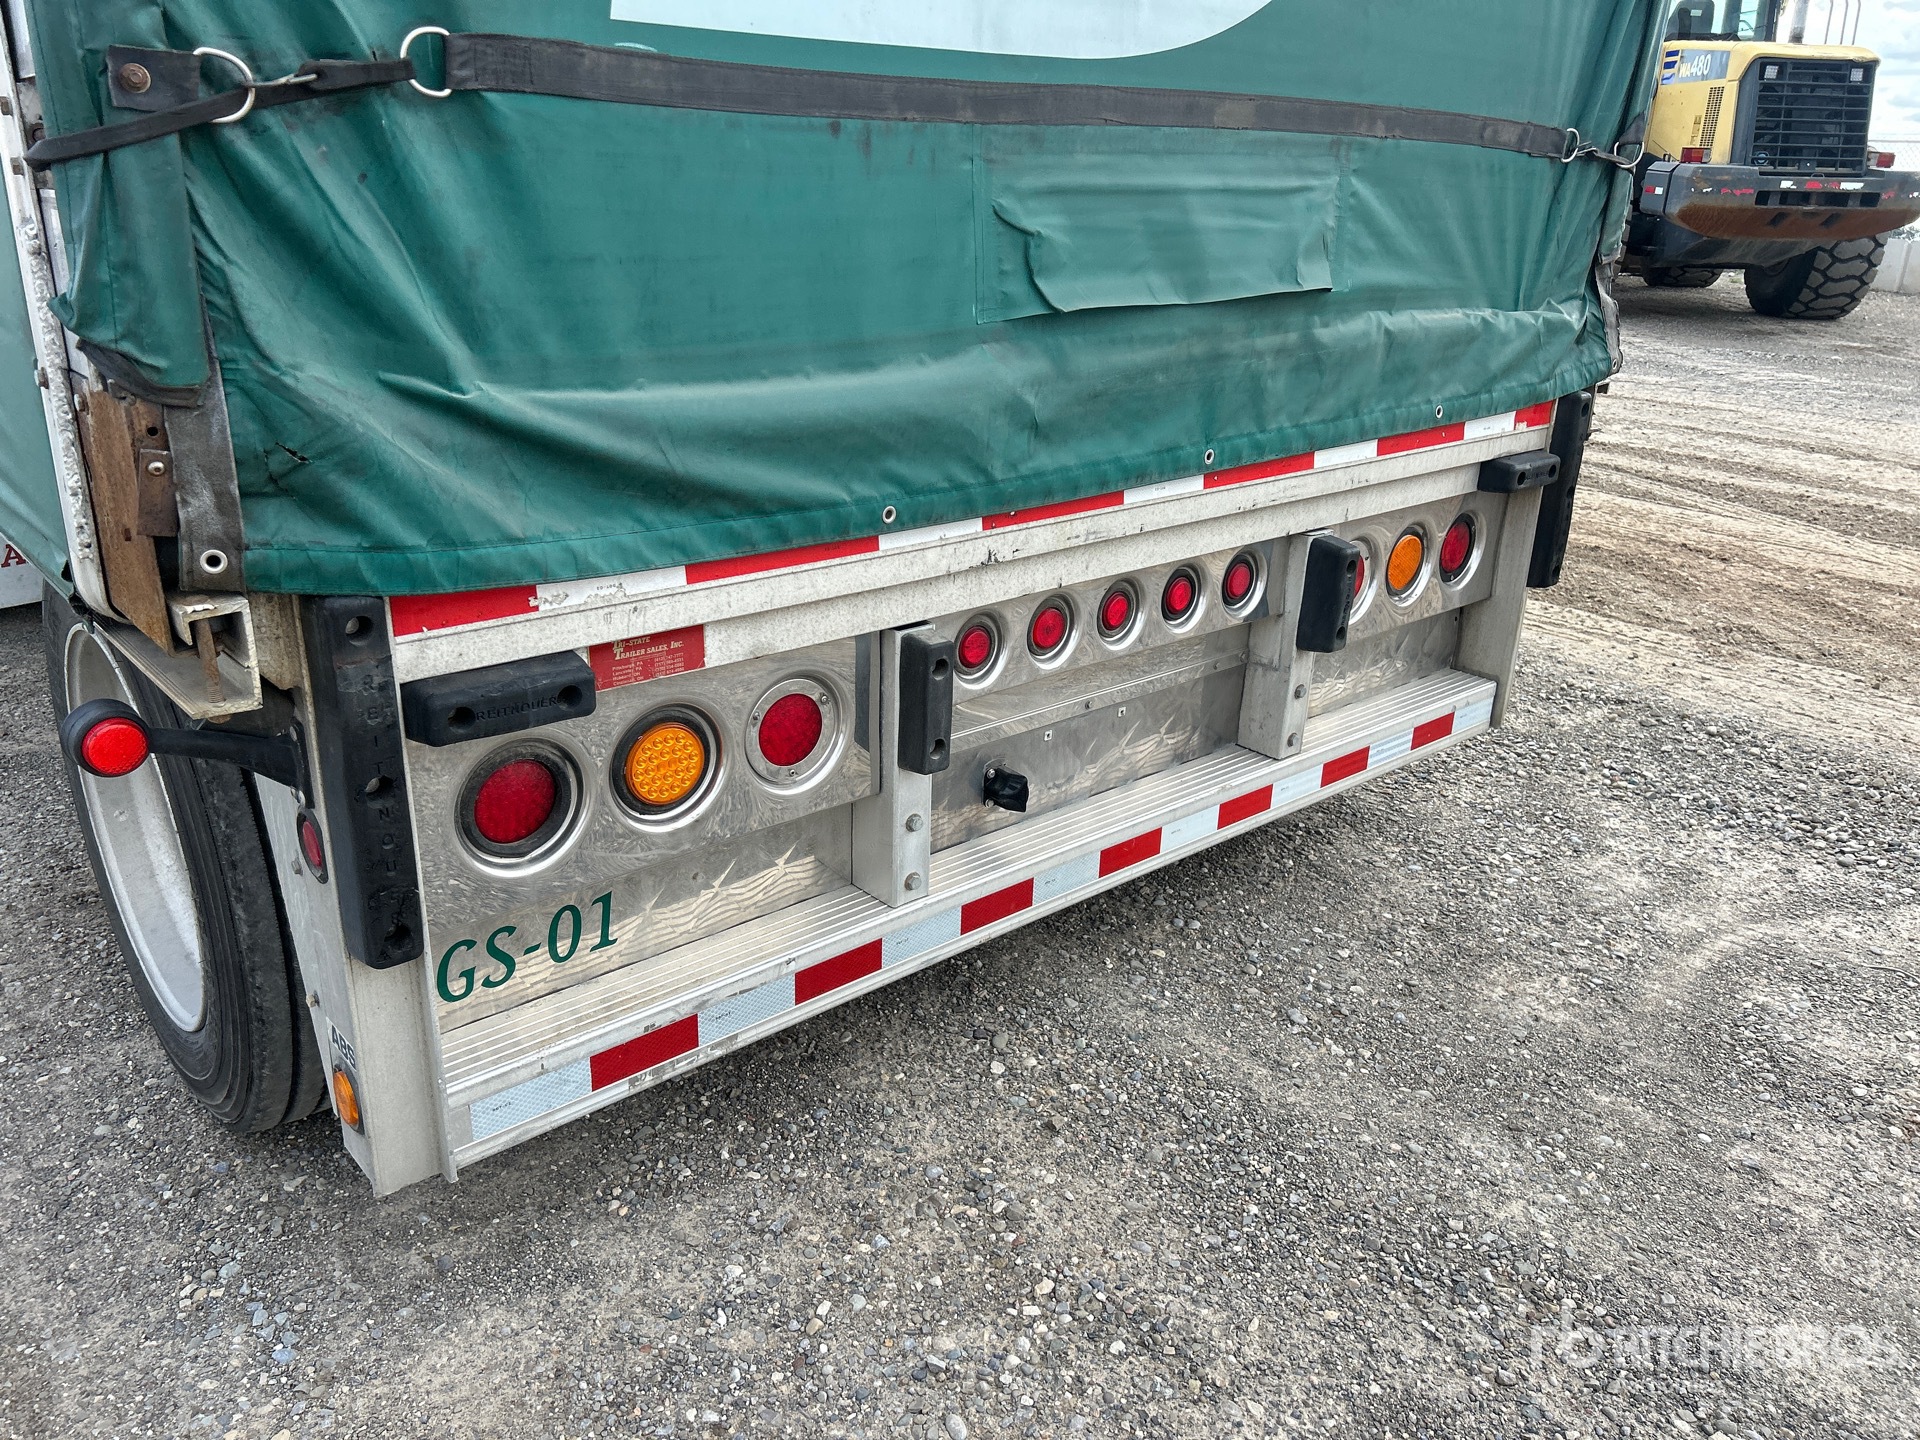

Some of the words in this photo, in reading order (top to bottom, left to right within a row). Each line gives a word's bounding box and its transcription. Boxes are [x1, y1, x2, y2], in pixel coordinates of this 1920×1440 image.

[1679, 54, 1711, 78] WA480
[613, 647, 646, 661] TRAILER
[436, 890, 619, 1003] GS-01
[332, 1024, 357, 1071] ABS
